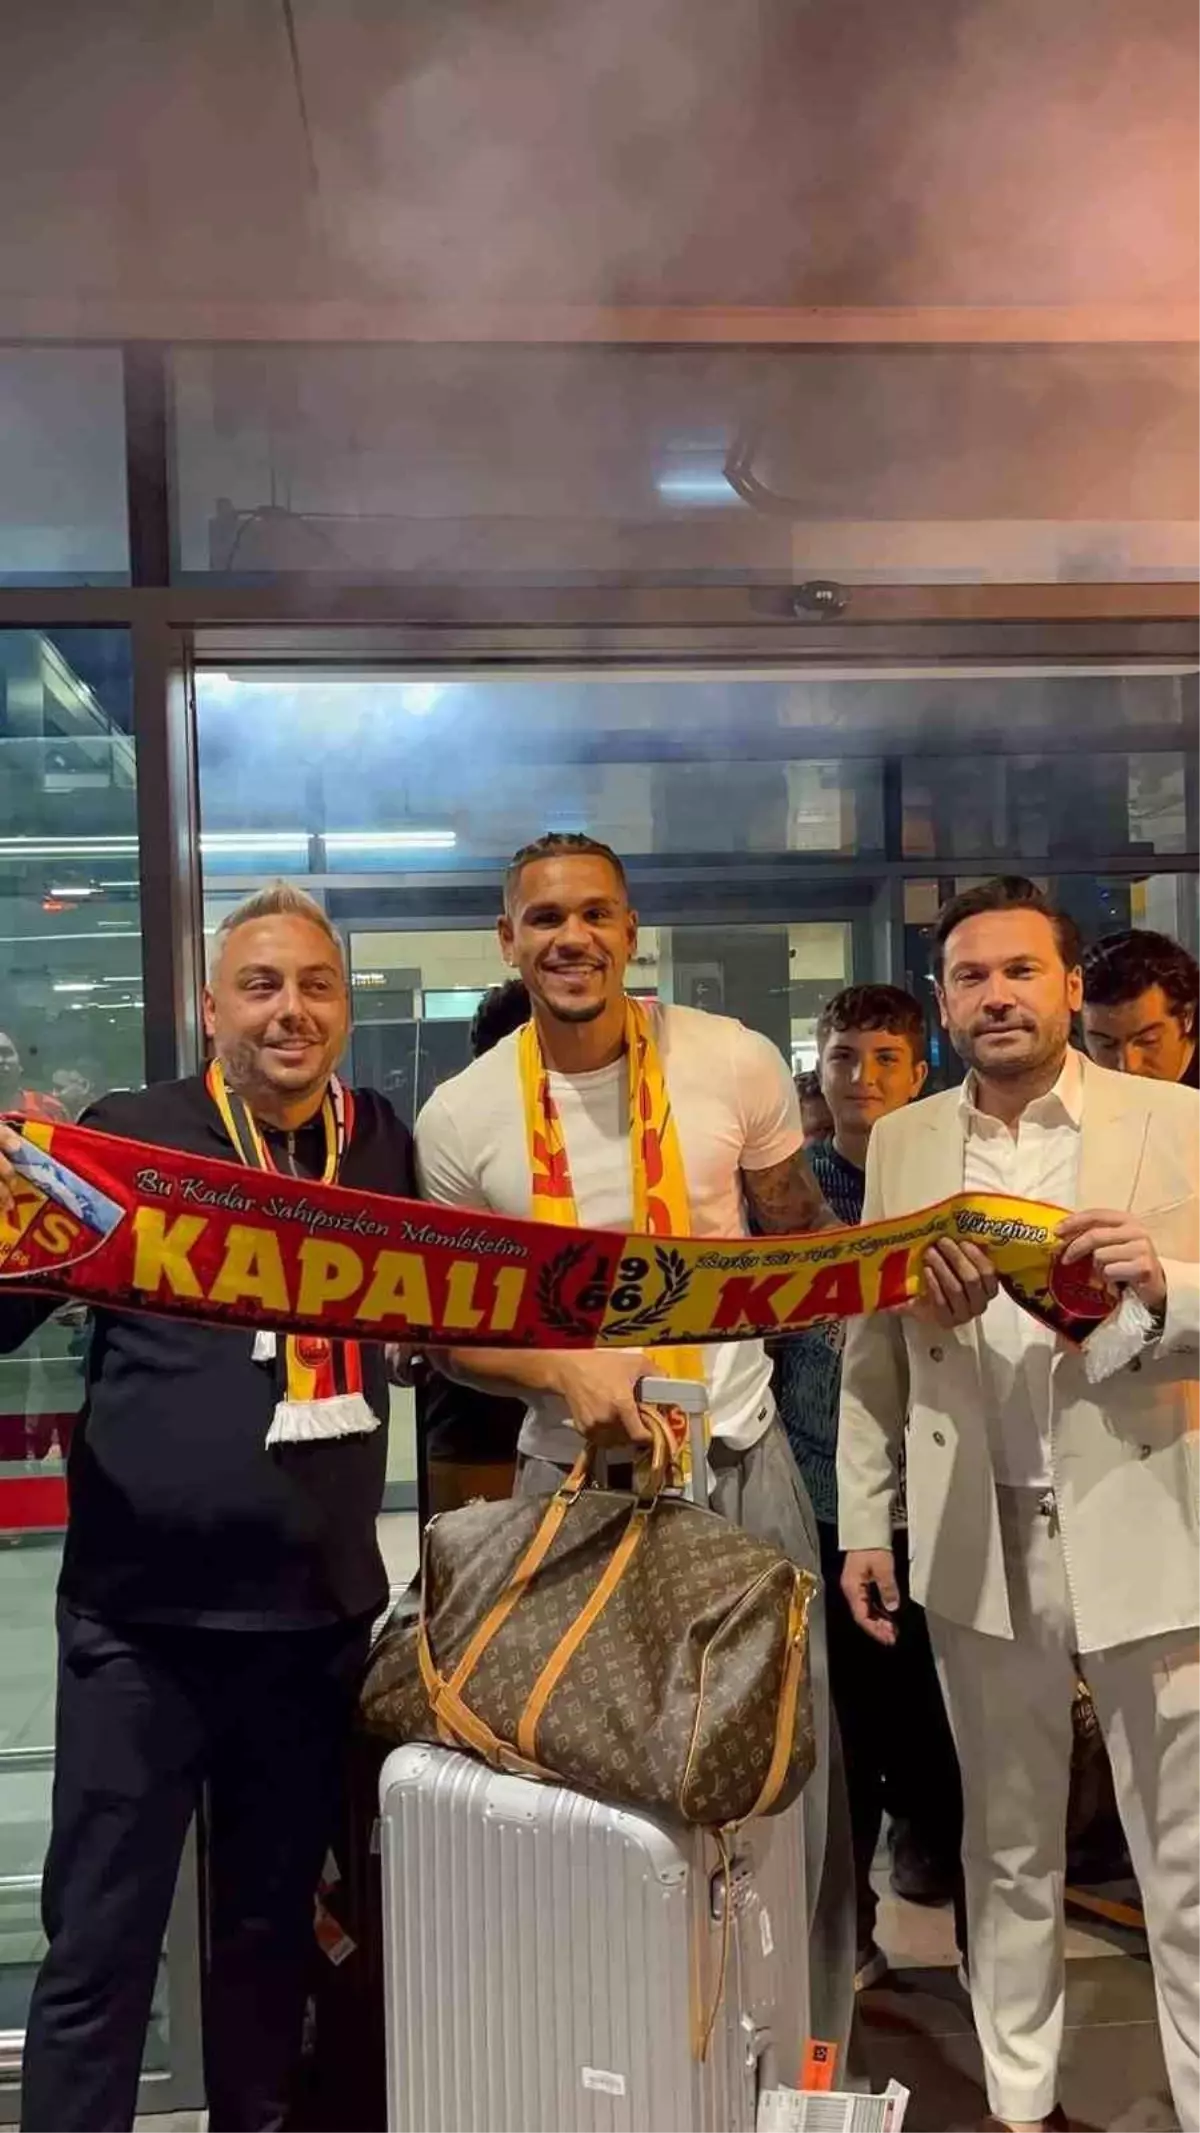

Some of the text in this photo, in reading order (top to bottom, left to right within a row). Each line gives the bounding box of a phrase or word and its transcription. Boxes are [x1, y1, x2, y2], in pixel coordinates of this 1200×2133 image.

[136, 1168, 173, 1196] Bu
[180, 1178, 256, 1213] Kadar
[262, 1196, 390, 1237] Sahipsizken
[132, 1205, 526, 1332] KAPALI
[709, 1247, 918, 1330] KAL
